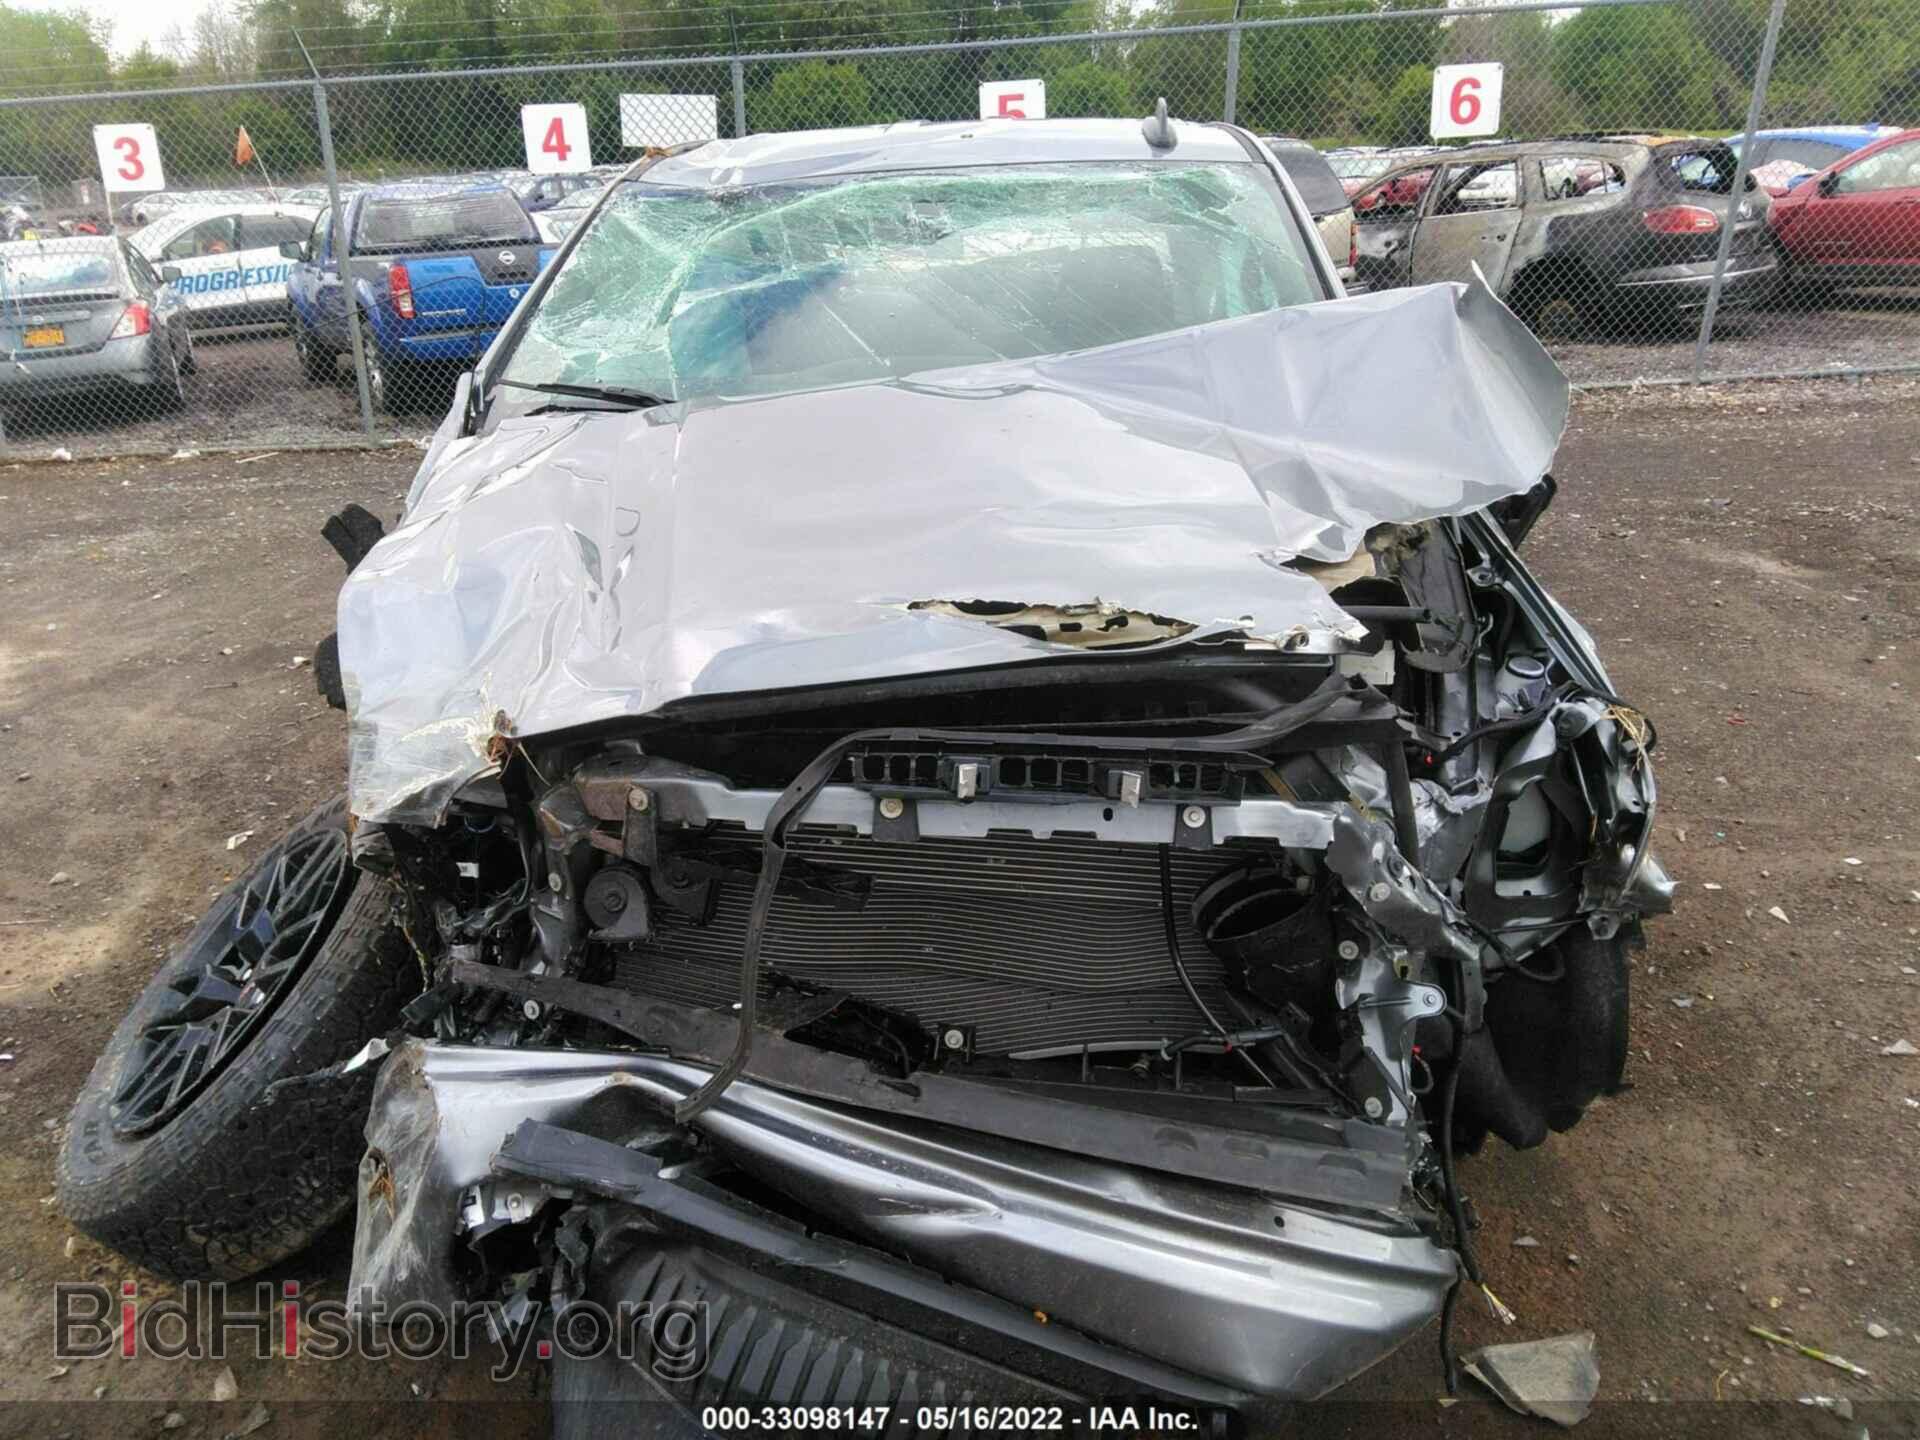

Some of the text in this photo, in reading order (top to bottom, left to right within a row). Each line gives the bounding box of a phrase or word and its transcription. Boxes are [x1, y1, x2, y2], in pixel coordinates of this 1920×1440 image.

[998, 93, 1026, 119] 5
[1449, 77, 1482, 125] 6
[113, 136, 145, 182] 3
[542, 116, 572, 162] 4
[174, 263, 288, 296] ROGRESSI
